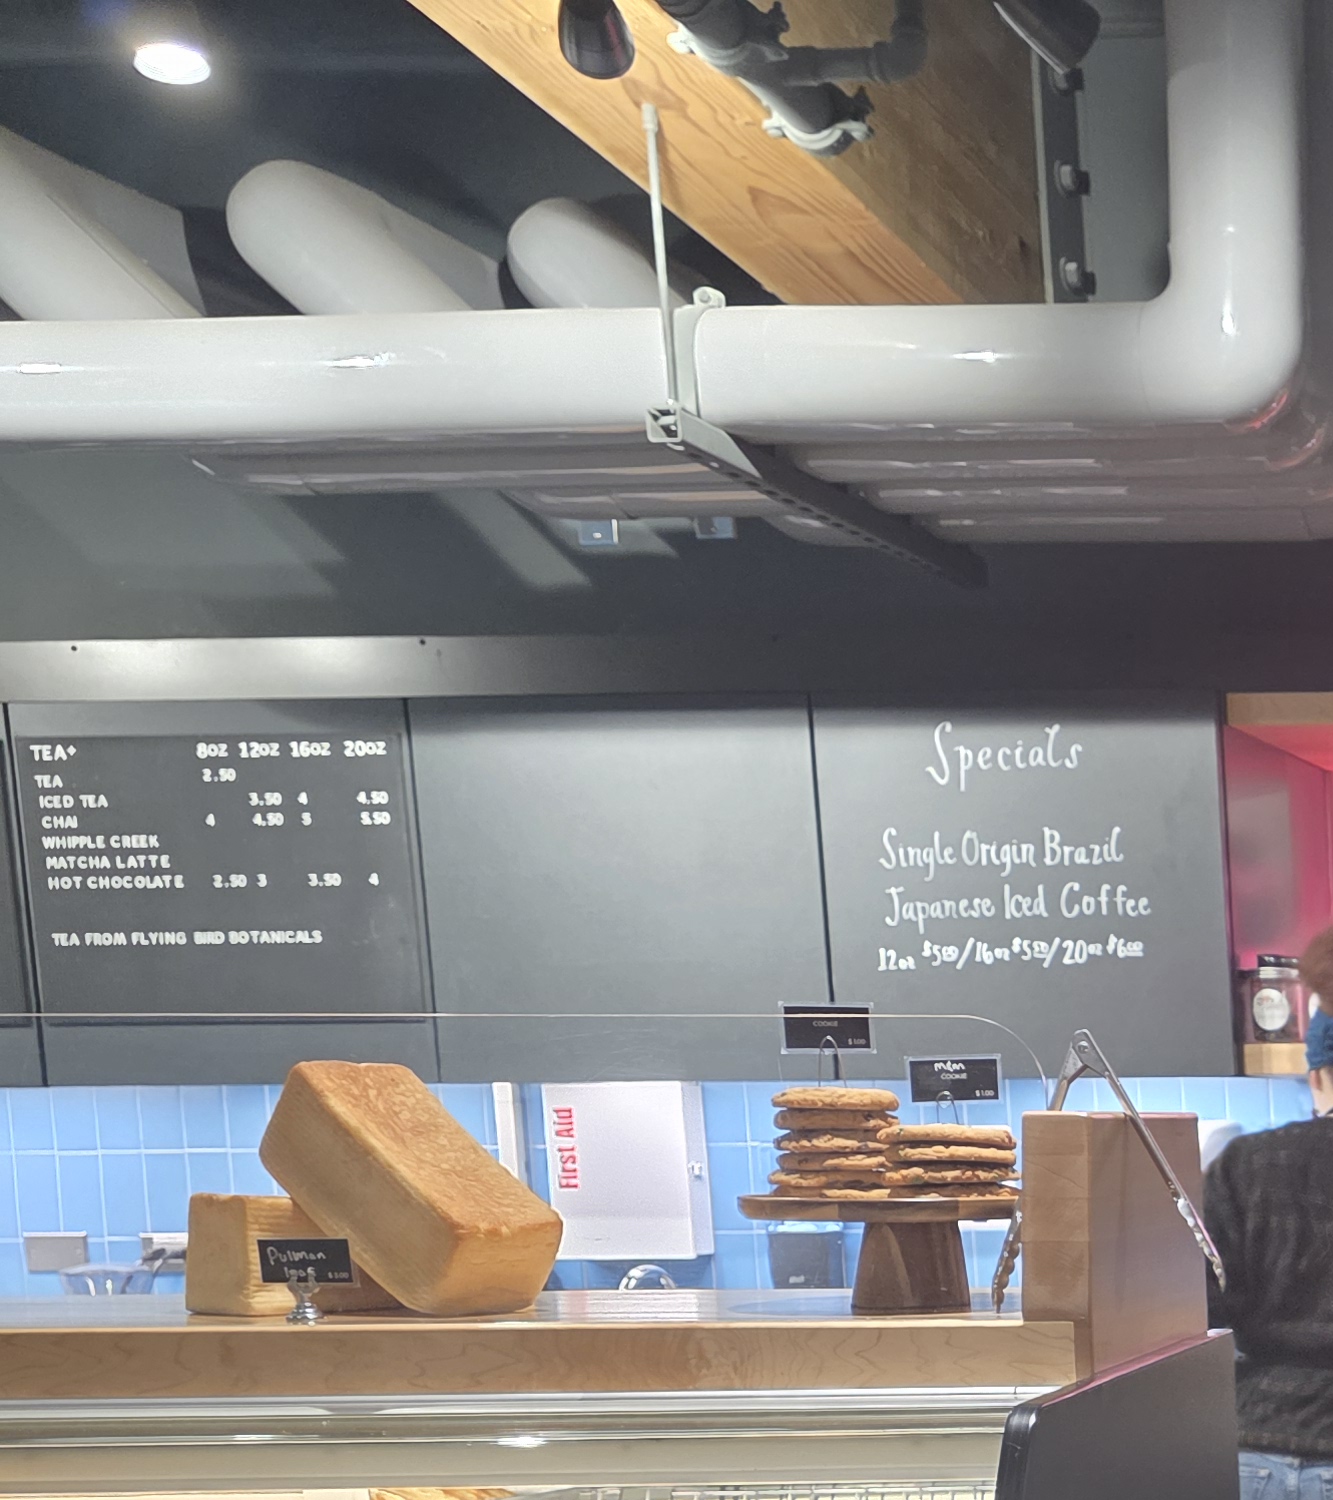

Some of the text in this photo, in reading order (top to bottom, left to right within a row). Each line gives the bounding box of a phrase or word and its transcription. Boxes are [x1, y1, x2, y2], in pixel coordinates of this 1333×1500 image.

[925, 720, 1083, 792] Specials
[33, 767, 237, 789] TEA 2.50
[38, 794, 75, 809] ICED
[78, 793, 109, 809] TEA
[297, 791, 309, 806] 4
[356, 790, 390, 805] 4.50
[41, 815, 79, 830] CHAI
[251, 811, 285, 827] 4.50
[41, 834, 160, 850] WHIPPLE CREEK
[45, 854, 171, 870] MATCHA LATTE
[878, 825, 1124, 882] Single Origin Brazil
[47, 876, 83, 891] HOT
[86, 874, 185, 890] CHOCOLATE
[884, 881, 1152, 935] Japanese Iced Coffee
[51, 929, 323, 947] TEA FROM FLYING BIRD BOTANICALS
[812, 1019, 839, 1028] COOKIE
[940, 1072, 968, 1080] COOKIE
[553, 1106, 580, 1190] First Aid
